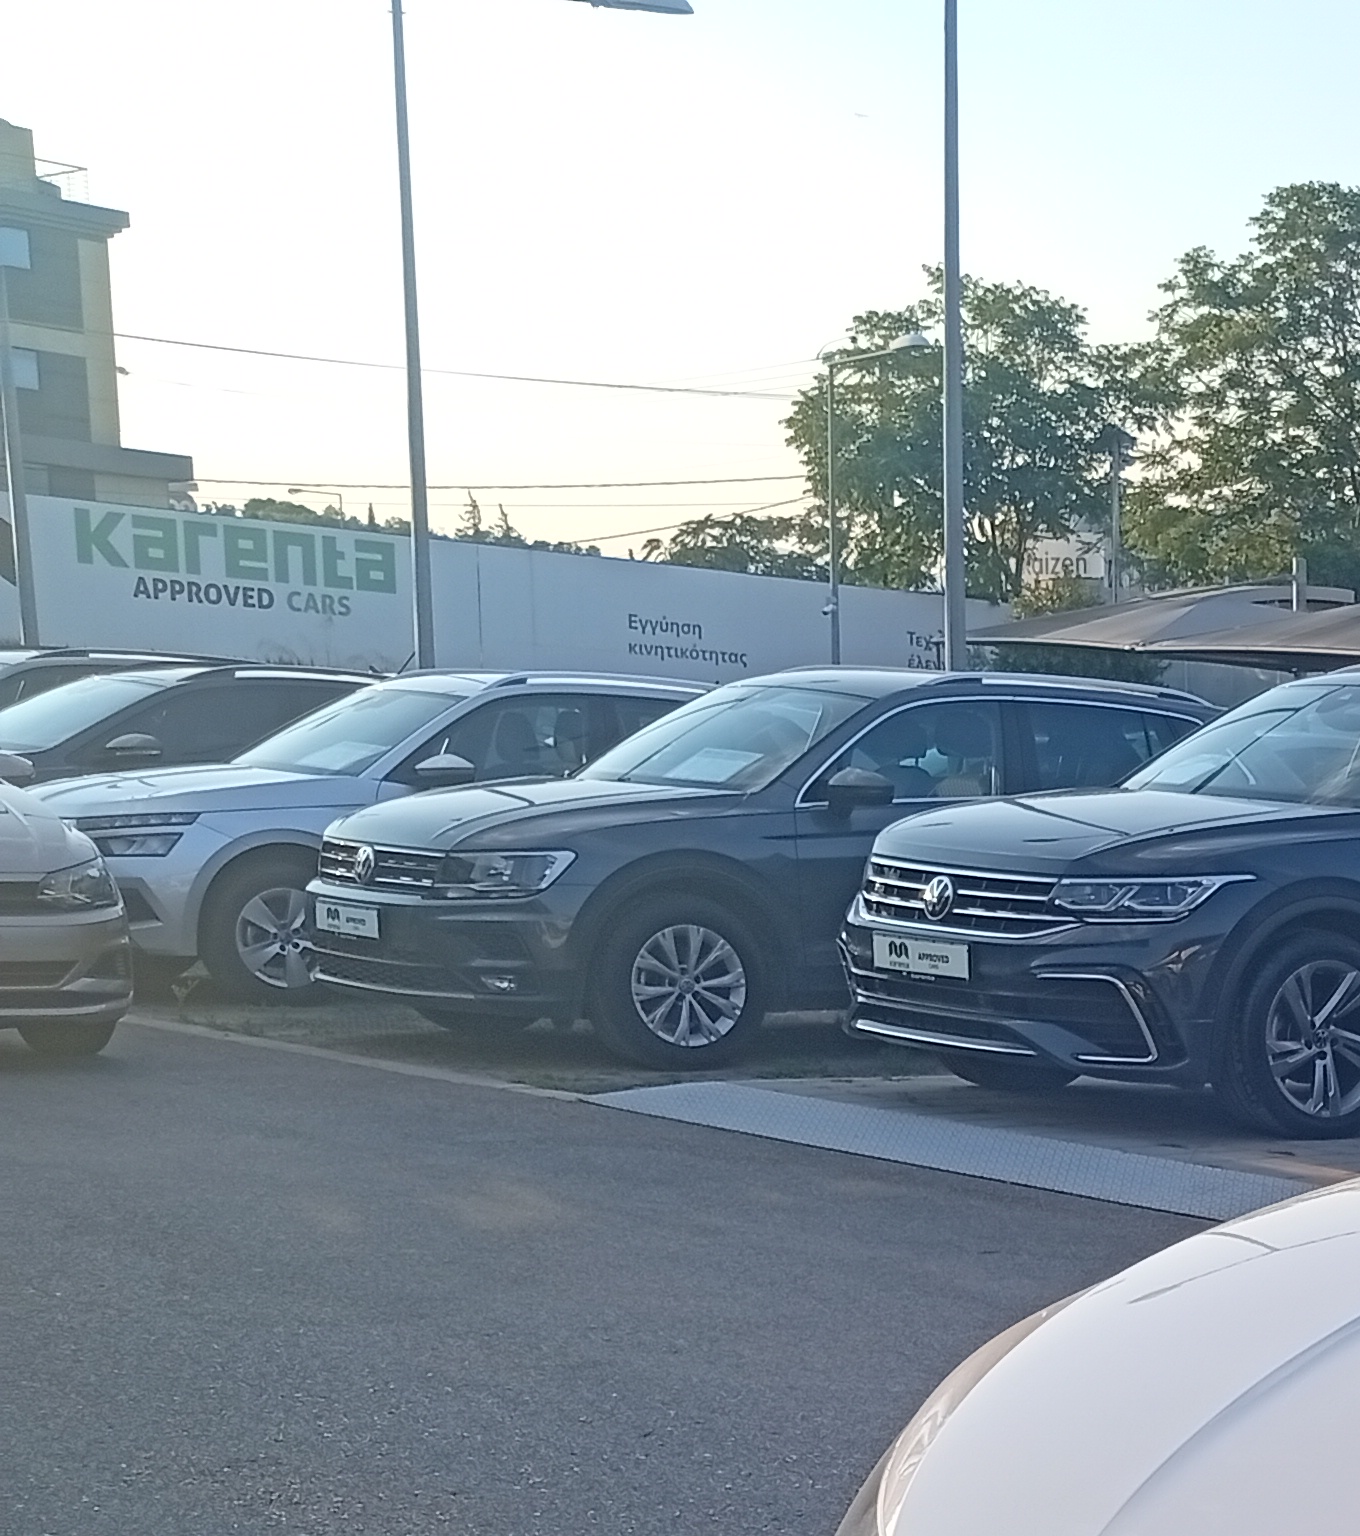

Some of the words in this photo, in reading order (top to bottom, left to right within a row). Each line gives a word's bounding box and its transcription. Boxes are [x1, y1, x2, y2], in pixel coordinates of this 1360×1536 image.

[133, 576, 275, 610] APPROVED
[287, 591, 351, 616] CARS
[628, 613, 702, 639] Εγγύηση
[628, 643, 748, 668] κινητικότητας
